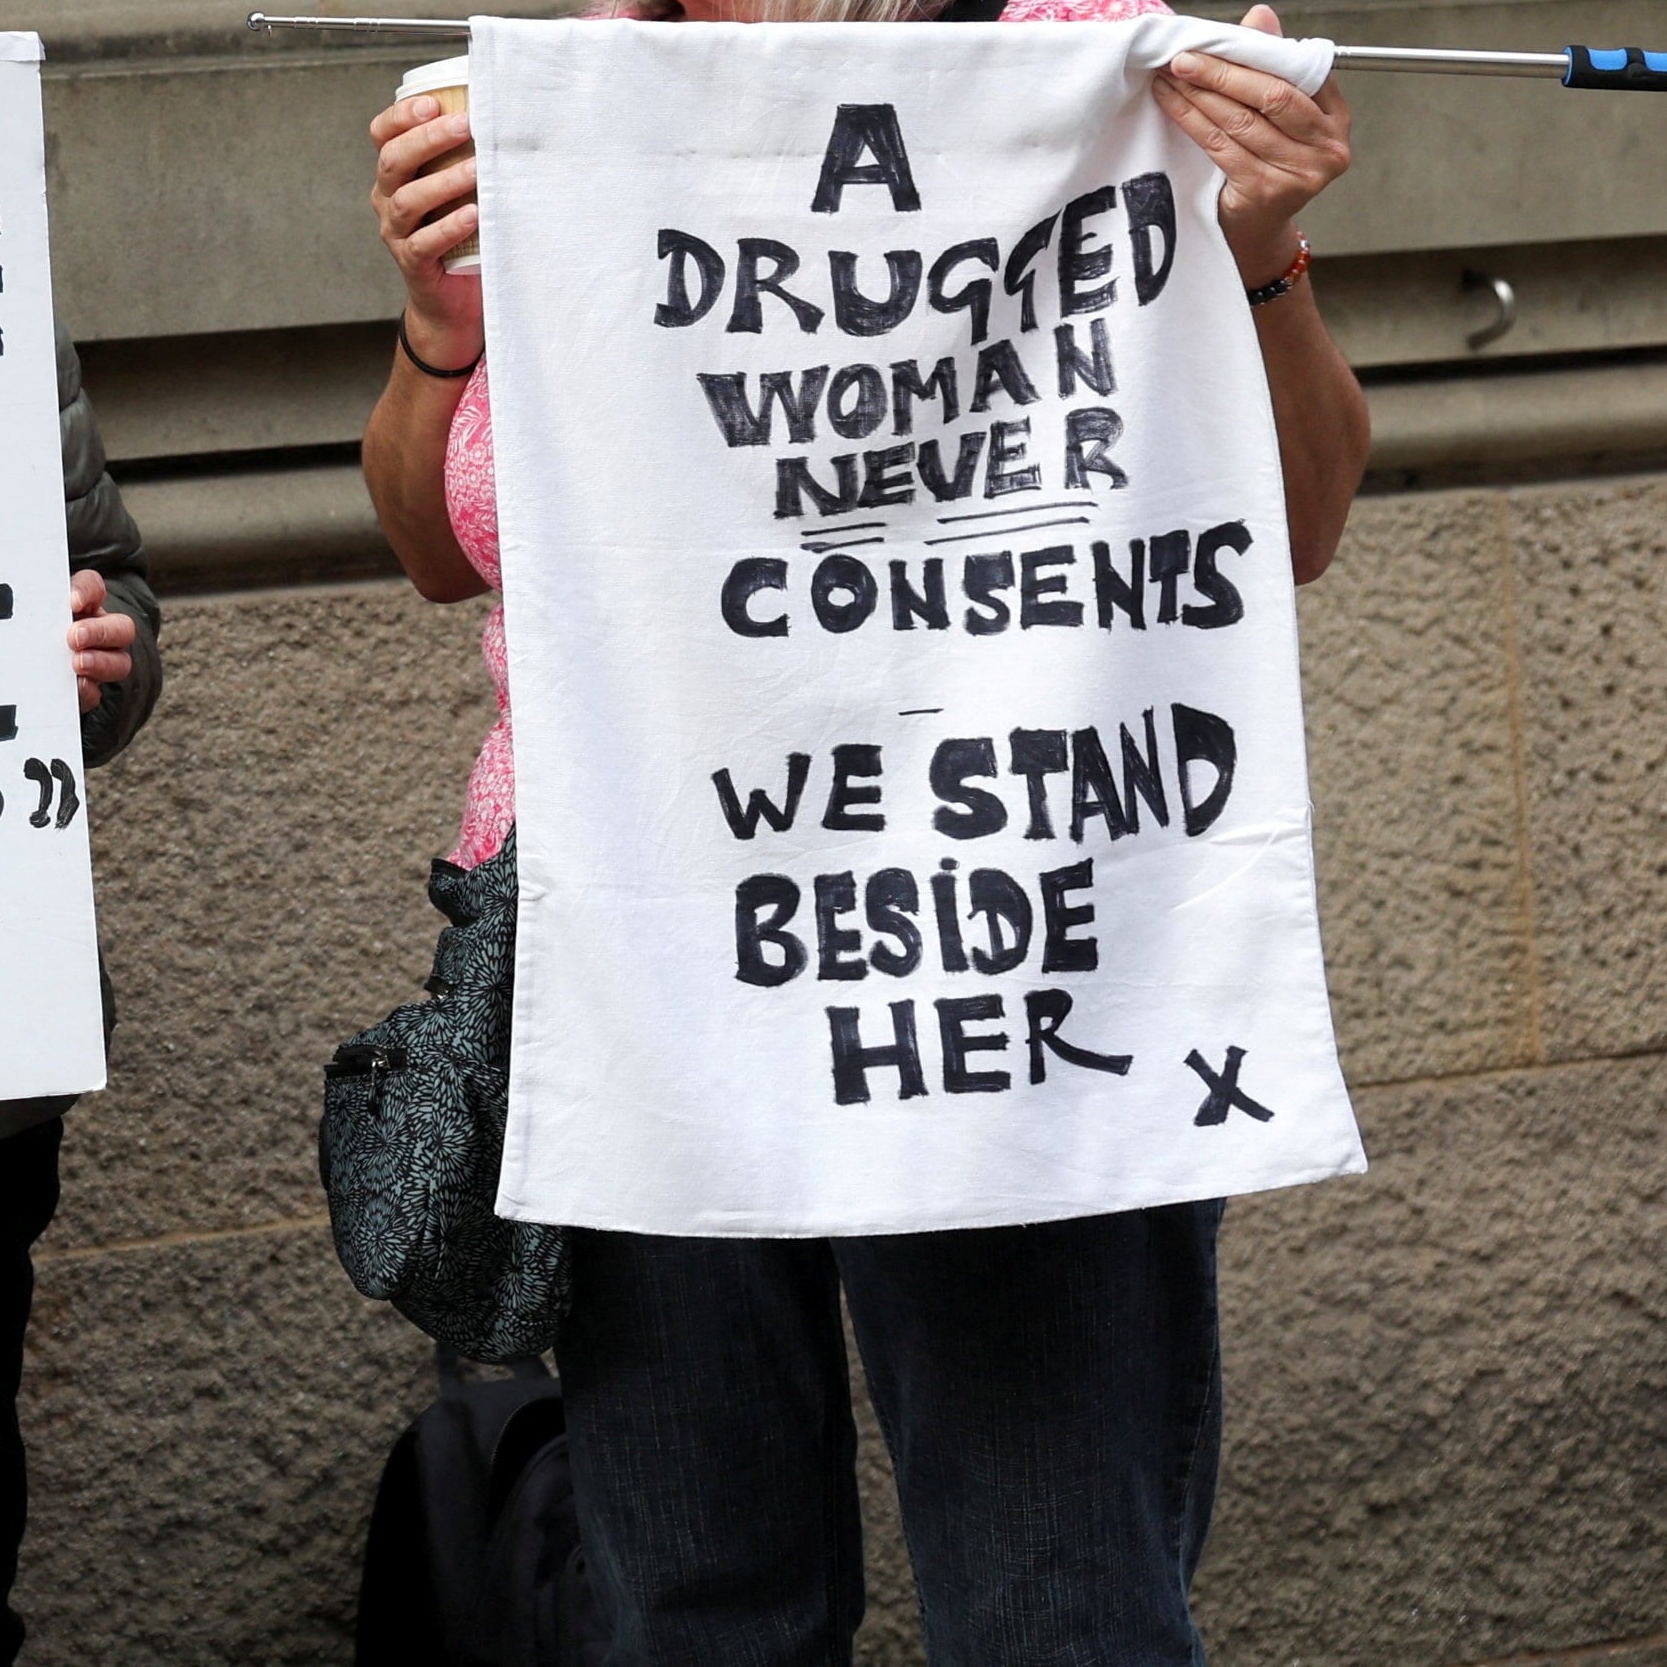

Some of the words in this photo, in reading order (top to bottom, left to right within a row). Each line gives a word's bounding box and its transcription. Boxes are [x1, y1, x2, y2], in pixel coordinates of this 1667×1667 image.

[810, 102, 922, 214] A
[653, 171, 1178, 346] DRUGGED
[697, 318, 1119, 448] WOMAN
[773, 406, 1128, 520] NEVER
[720, 520, 1254, 639] CONSENTS
[711, 743, 887, 841] WE
[929, 702, 1237, 846] STAND
[816, 988, 1134, 1106] HER
